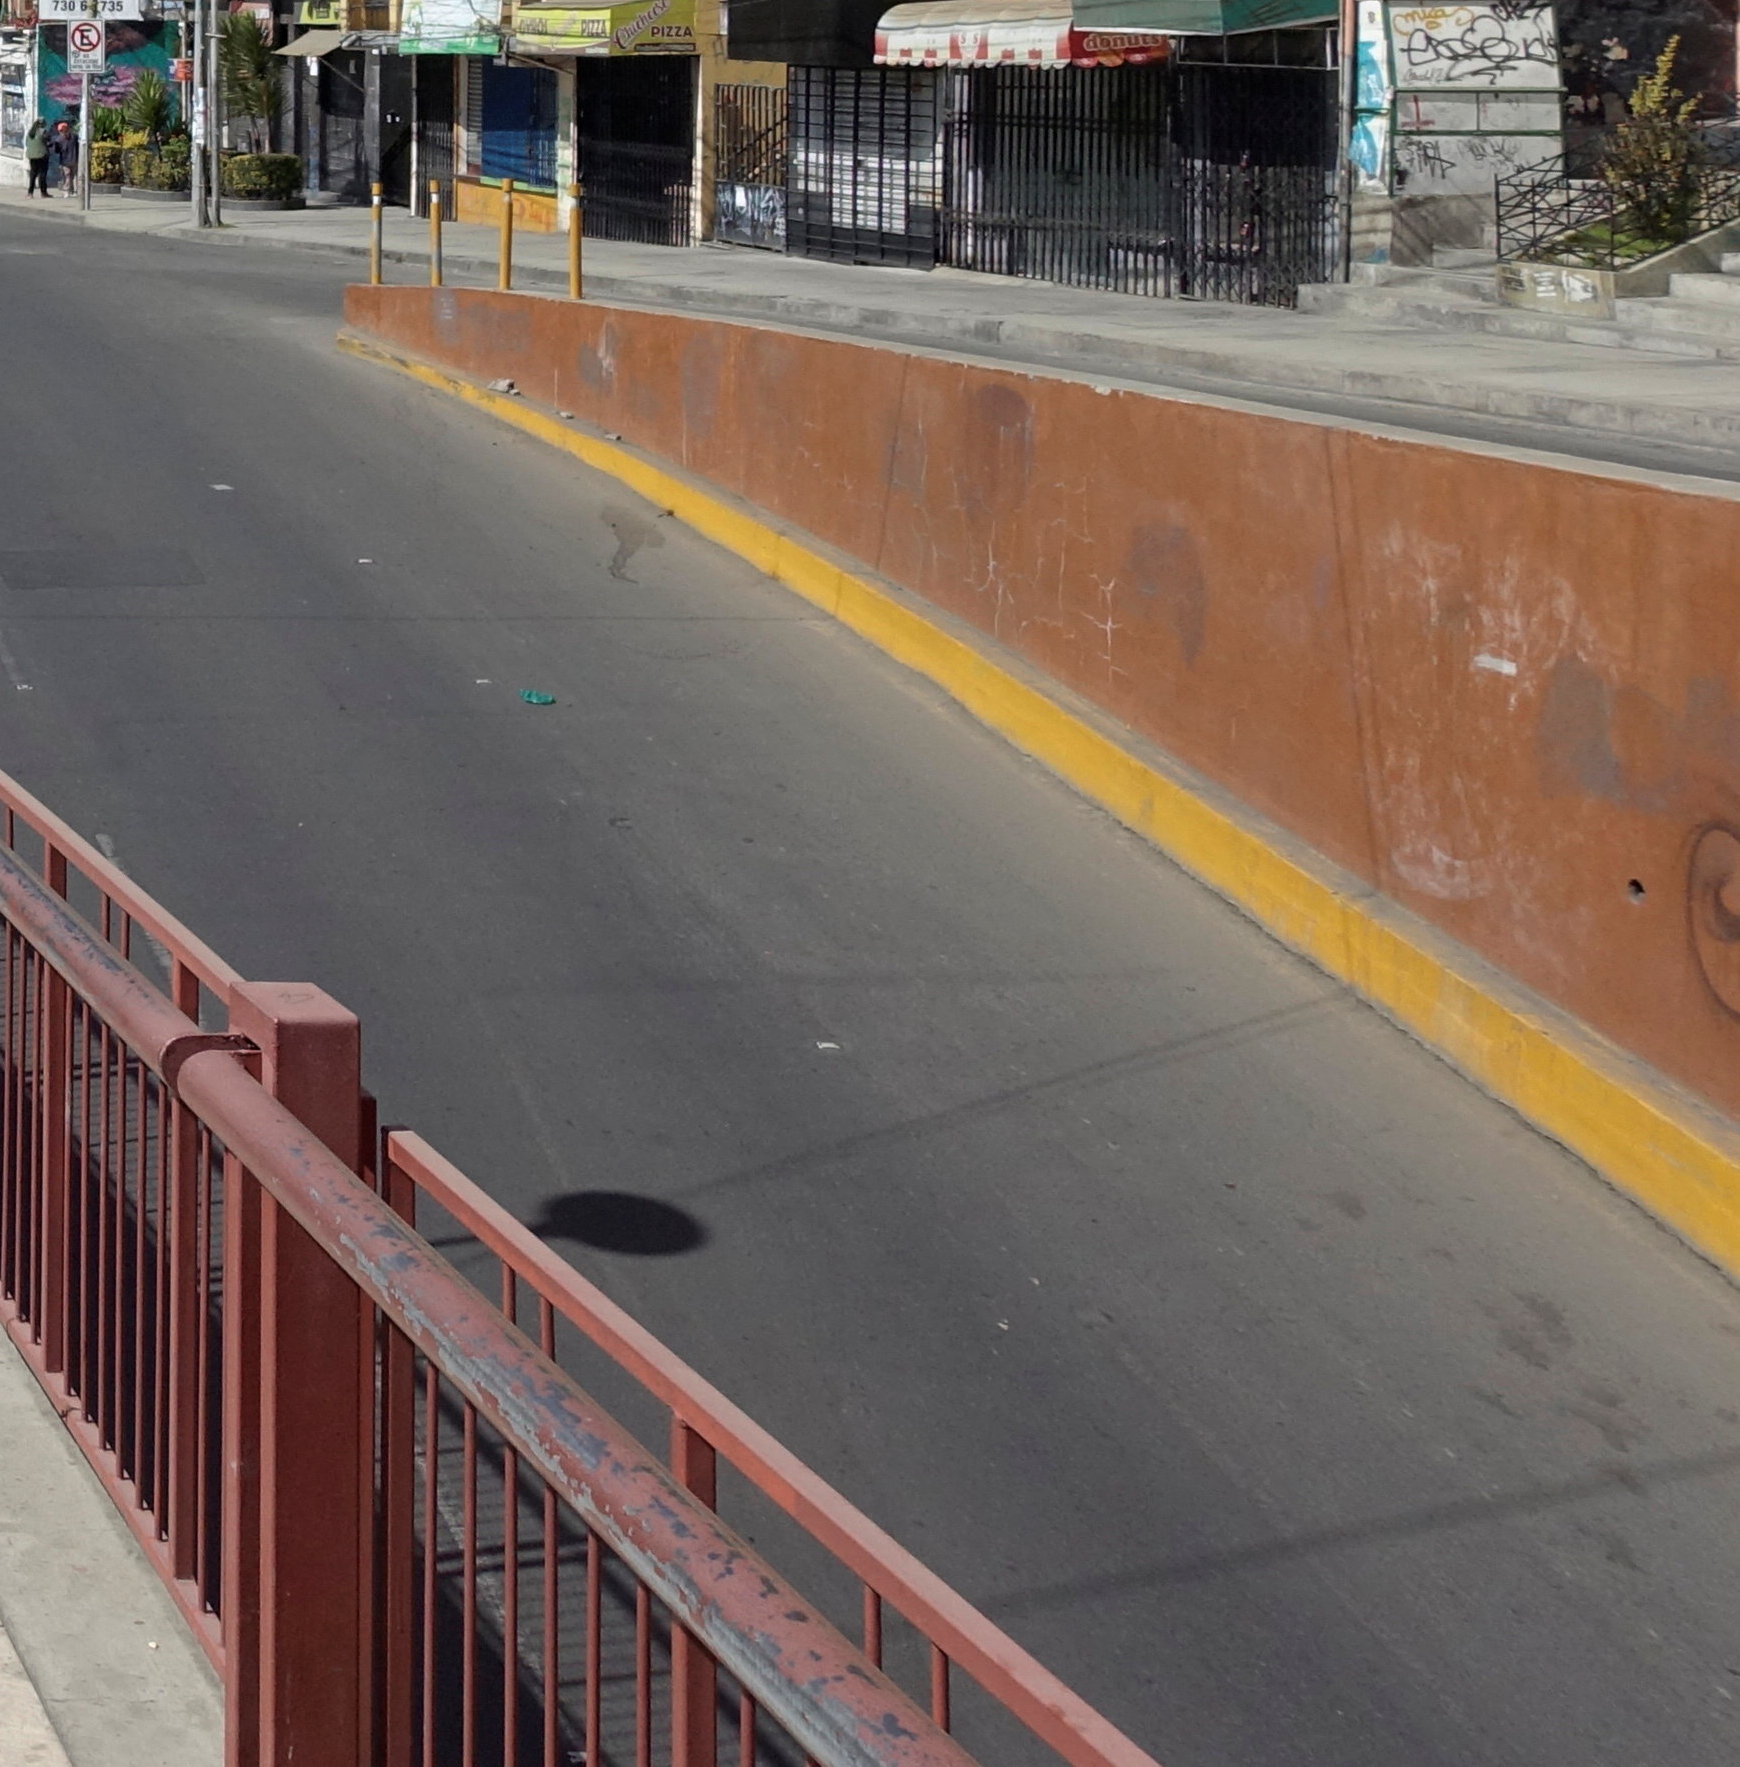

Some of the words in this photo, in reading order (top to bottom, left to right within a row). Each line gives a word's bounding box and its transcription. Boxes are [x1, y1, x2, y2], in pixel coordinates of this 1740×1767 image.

[53, 0, 75, 11] 730
[101, 0, 123, 11] 735
[651, 26, 693, 37] PIZZA
[1082, 33, 1162, 50] donuts
